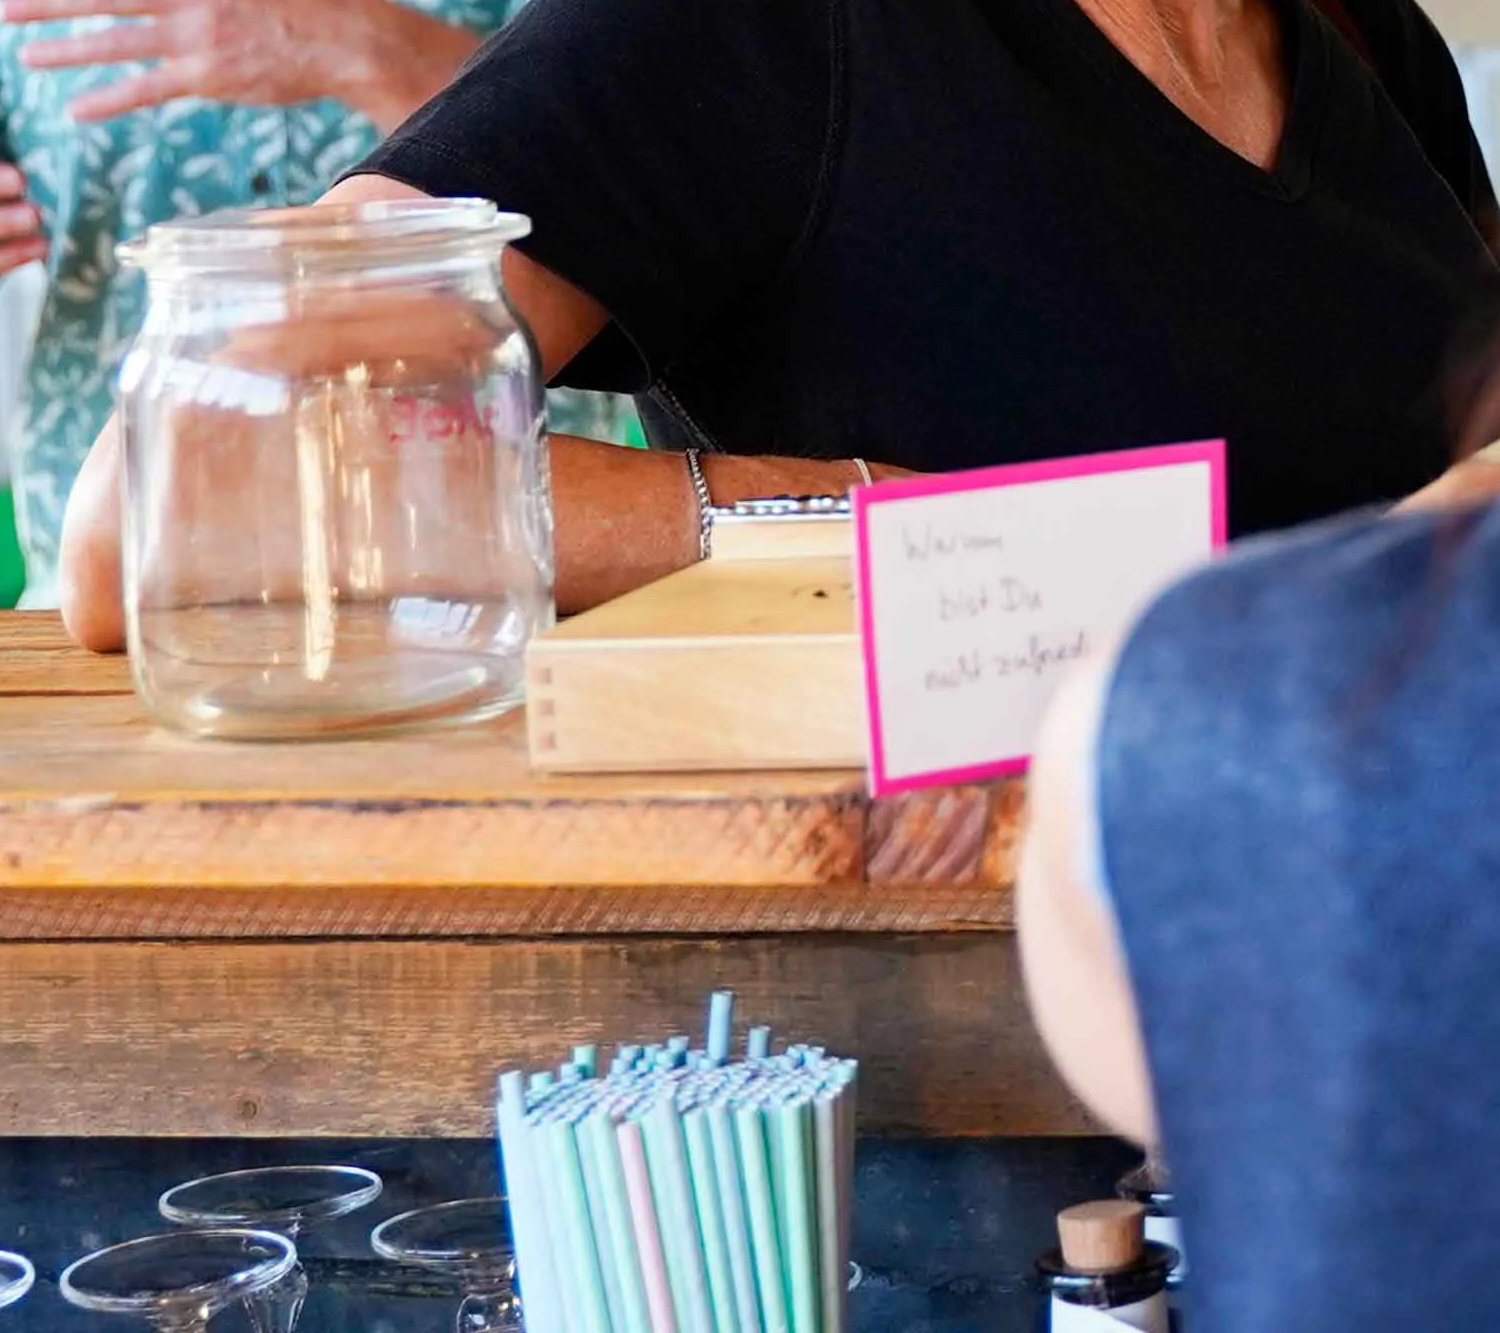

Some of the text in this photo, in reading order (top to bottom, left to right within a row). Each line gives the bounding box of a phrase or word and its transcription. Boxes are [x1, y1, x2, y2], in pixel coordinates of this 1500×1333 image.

[901, 521, 1002, 562] Warum
[939, 576, 1043, 621] bist Du
